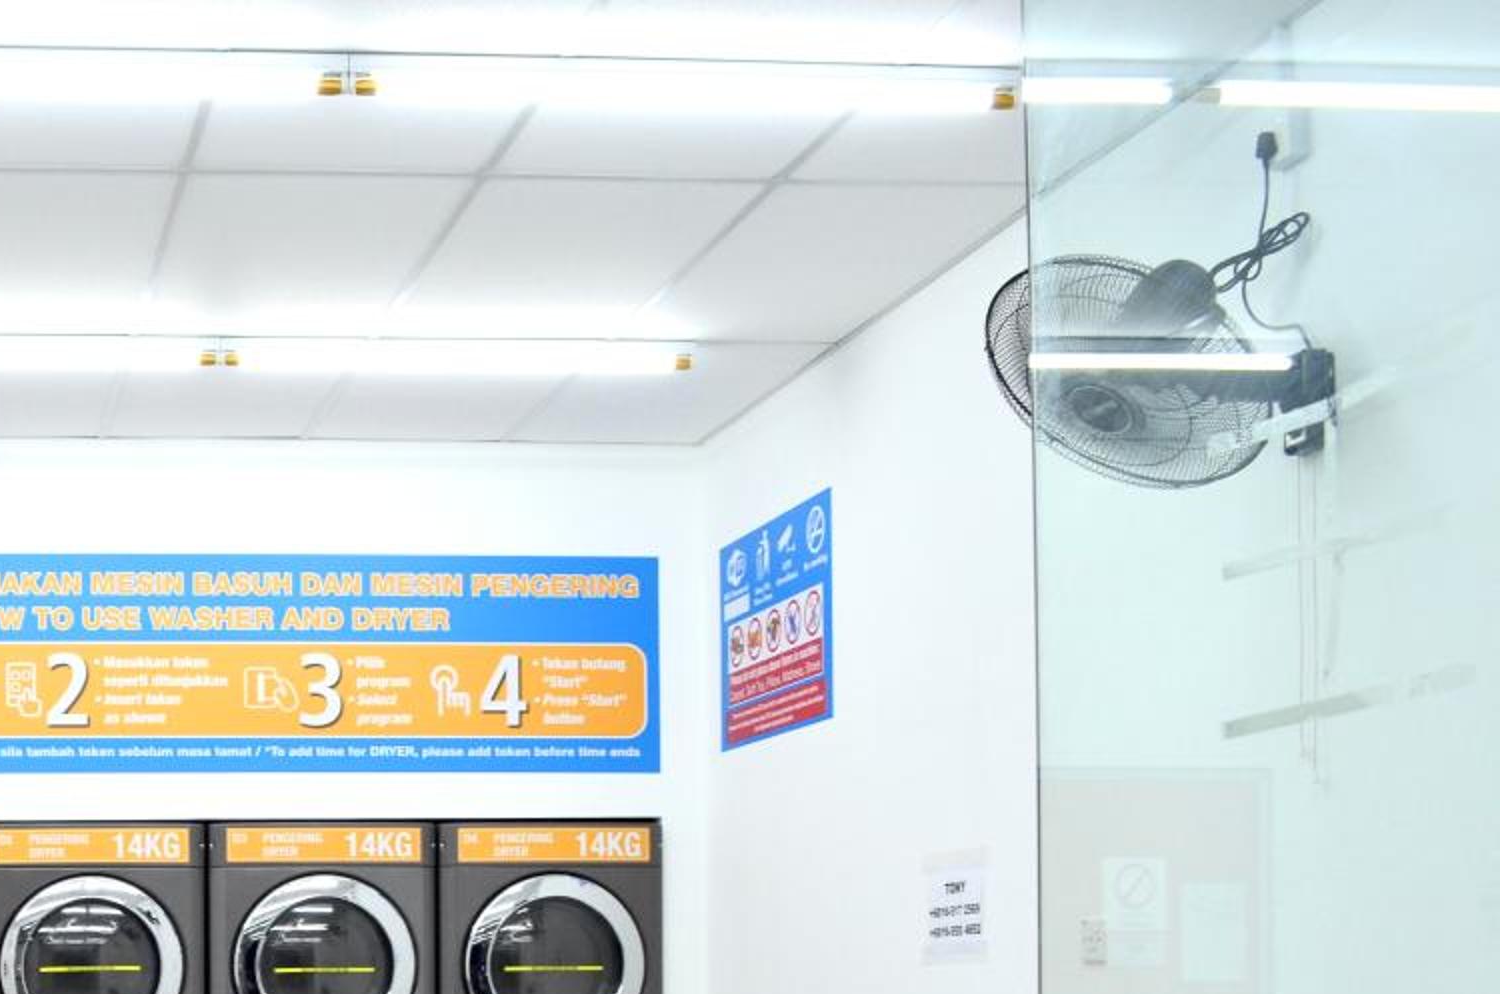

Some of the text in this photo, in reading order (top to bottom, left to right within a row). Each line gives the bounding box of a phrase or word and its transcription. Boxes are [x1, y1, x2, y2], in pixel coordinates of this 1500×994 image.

[90, 572, 185, 597] MESIN
[192, 572, 293, 596] BASUH
[302, 572, 363, 596] DAN
[370, 572, 464, 596] MESIN
[471, 573, 640, 598] PENGERING
[33, 606, 75, 631] TO
[82, 606, 140, 631] USE
[149, 606, 274, 631] WASHER
[282, 607, 345, 631] AND
[352, 607, 450, 632] DRYER
[46, 652, 91, 728] 2
[298, 652, 344, 729] 3
[480, 654, 529, 728] 4
[1, 747, 24, 757] sila
[27, 747, 75, 757] tambah
[79, 747, 115, 757] token
[119, 747, 174, 757] sebelum
[177, 748, 211, 757] masa
[214, 747, 251, 757] tamat
[289, 747, 313, 757] add
[316, 747, 346, 757] time
[349, 747, 367, 757] for
[422, 747, 464, 759] please
[467, 747, 492, 757] add
[495, 747, 531, 757] token
[534, 747, 575, 757] before
[578, 747, 606, 757] time
[609, 747, 641, 757] ends
[113, 832, 181, 859] 14KG
[344, 831, 413, 857] 14KG
[575, 831, 642, 857] 14KG
